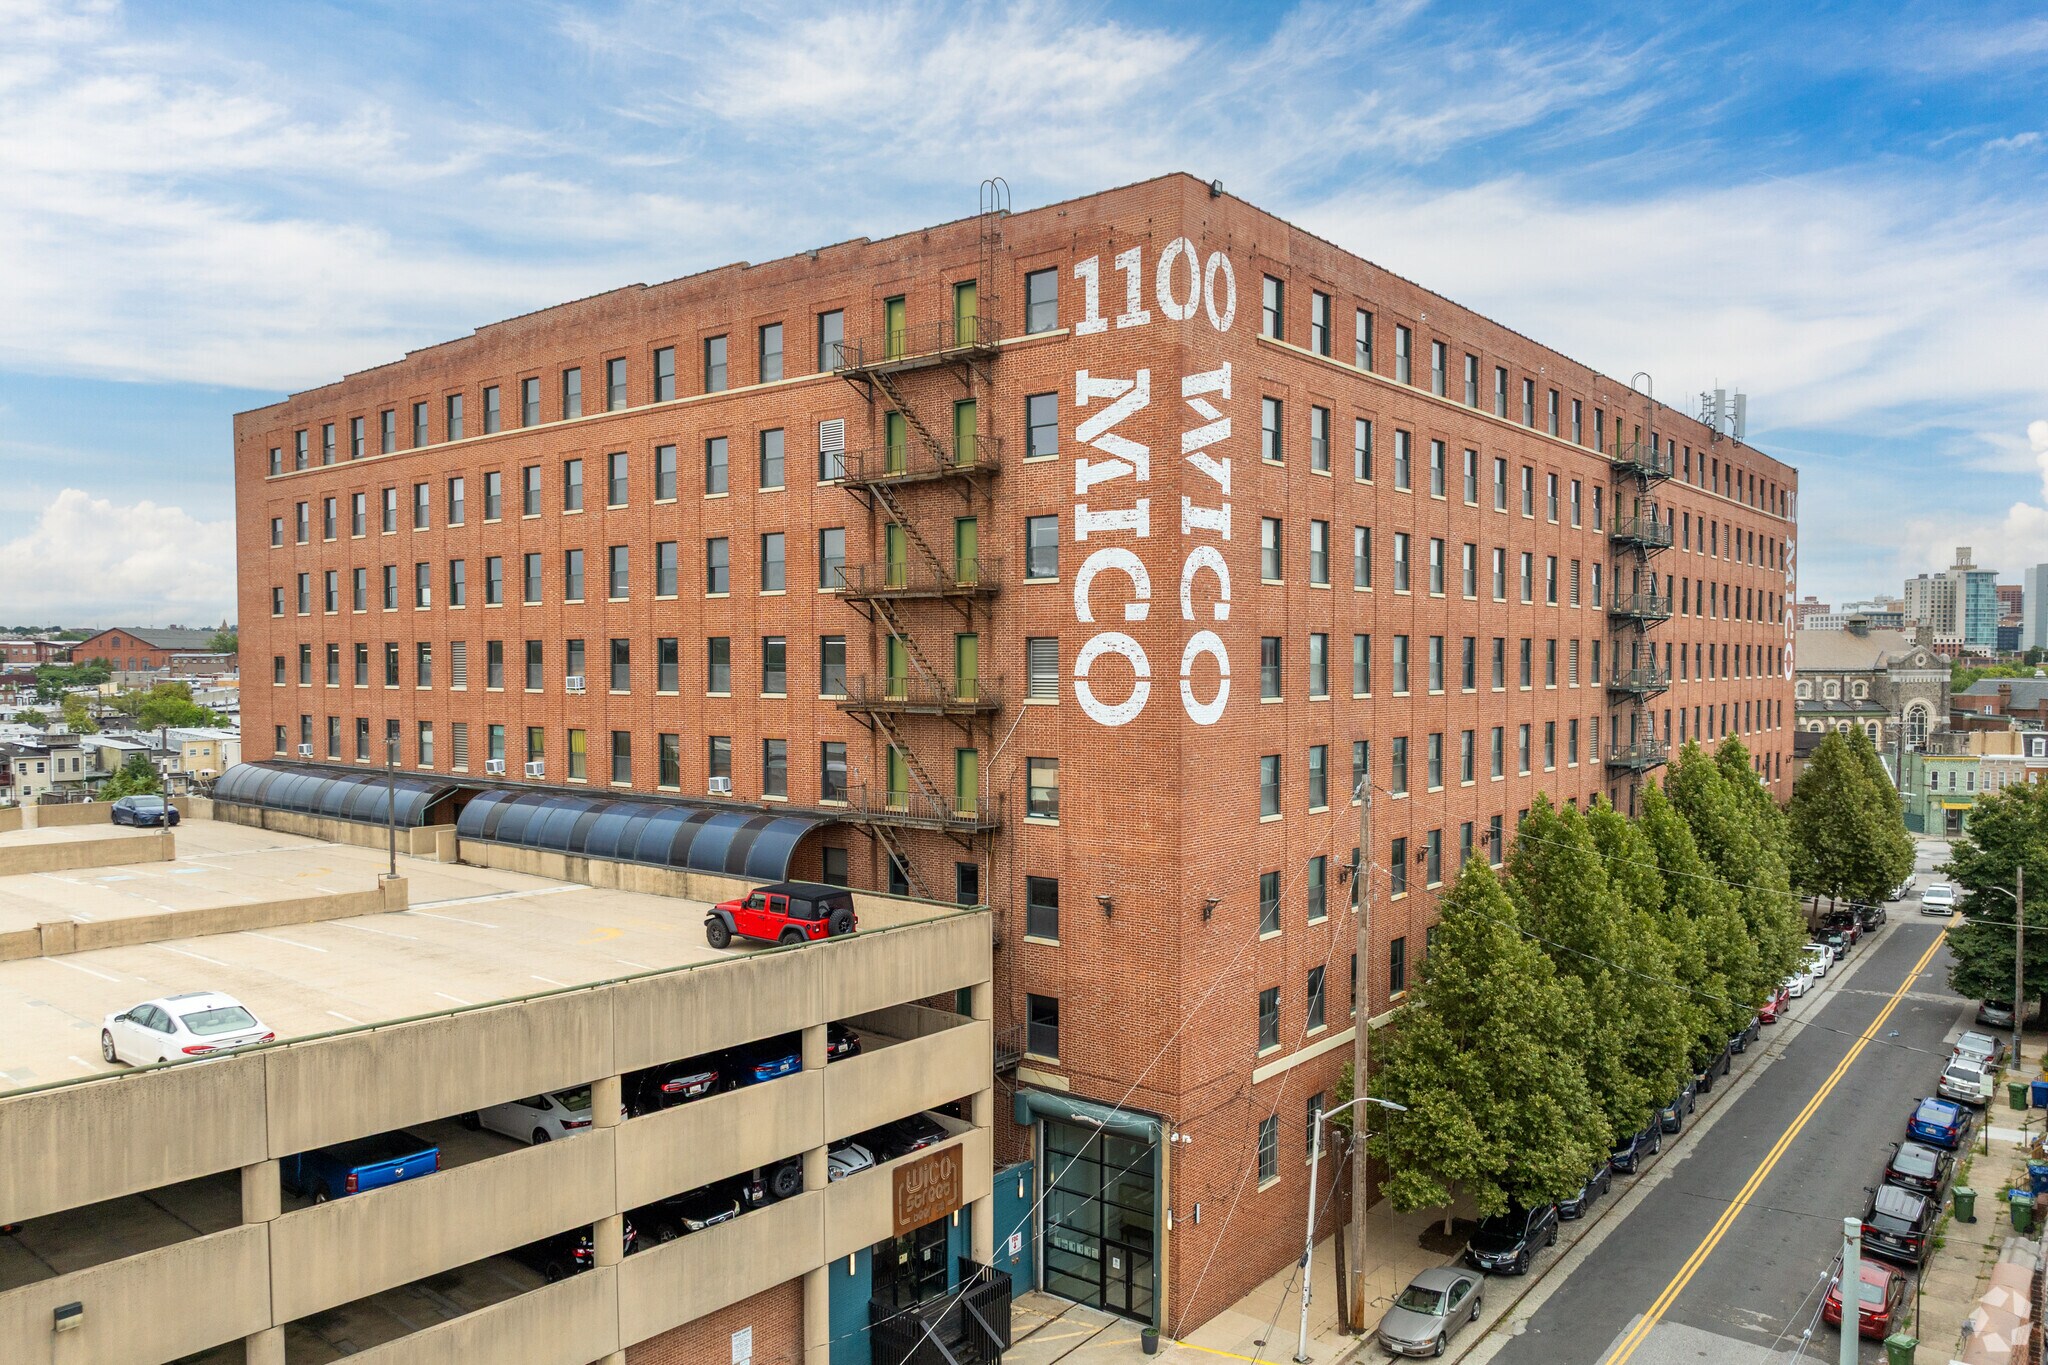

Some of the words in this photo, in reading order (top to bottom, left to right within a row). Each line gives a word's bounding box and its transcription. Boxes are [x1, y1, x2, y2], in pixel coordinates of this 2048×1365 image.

[1074, 236, 1237, 336] 1100
[1074, 369, 1151, 727] MICO
[1180, 361, 1232, 726] WICO
[1784, 535, 1795, 682] MICO
